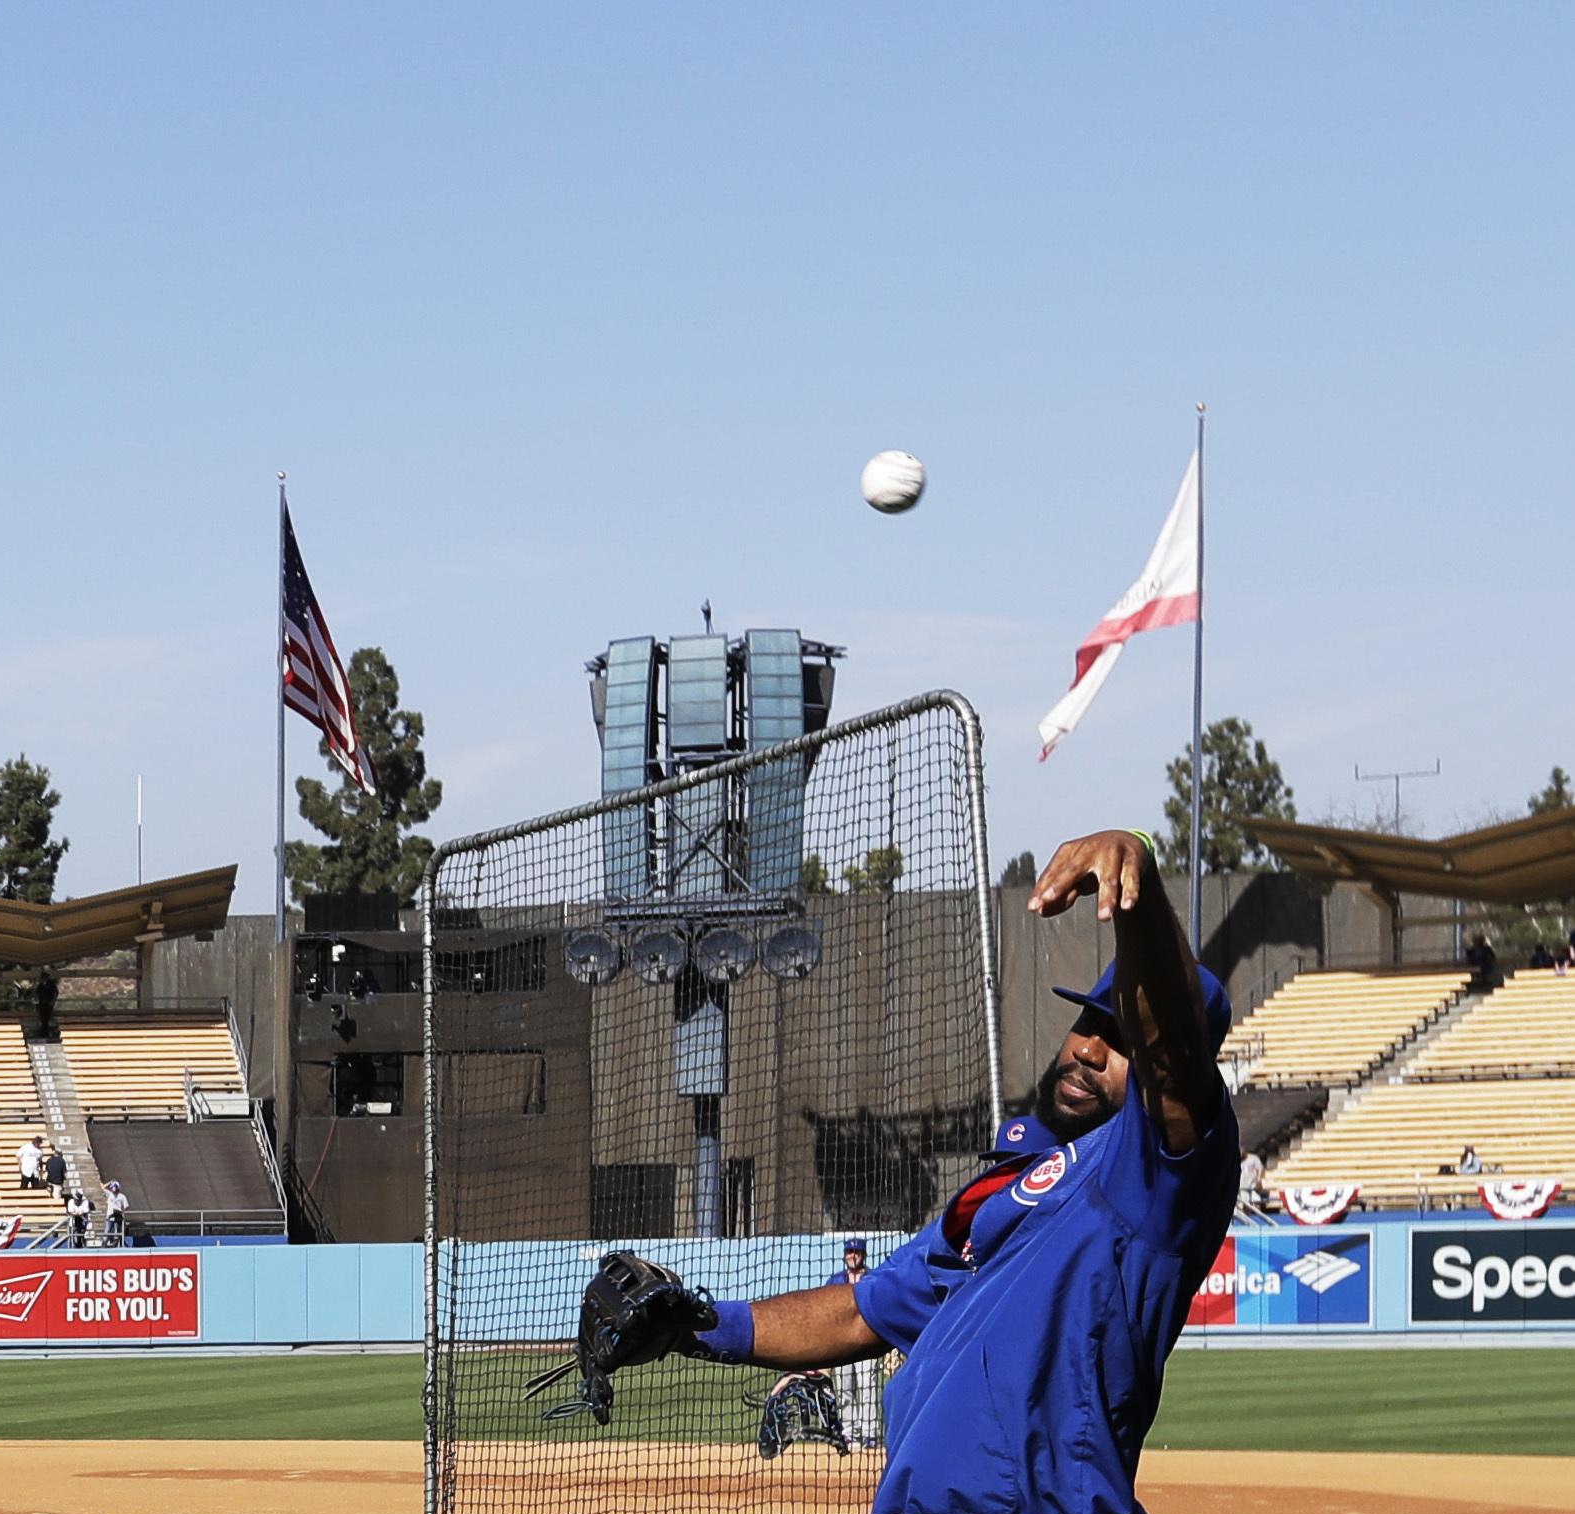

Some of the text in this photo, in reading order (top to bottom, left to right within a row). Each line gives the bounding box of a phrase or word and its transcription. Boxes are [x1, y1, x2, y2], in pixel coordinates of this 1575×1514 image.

[65, 1268, 193, 1293] THIS BUD'S
[66, 1297, 170, 1322] FOR YOU.
